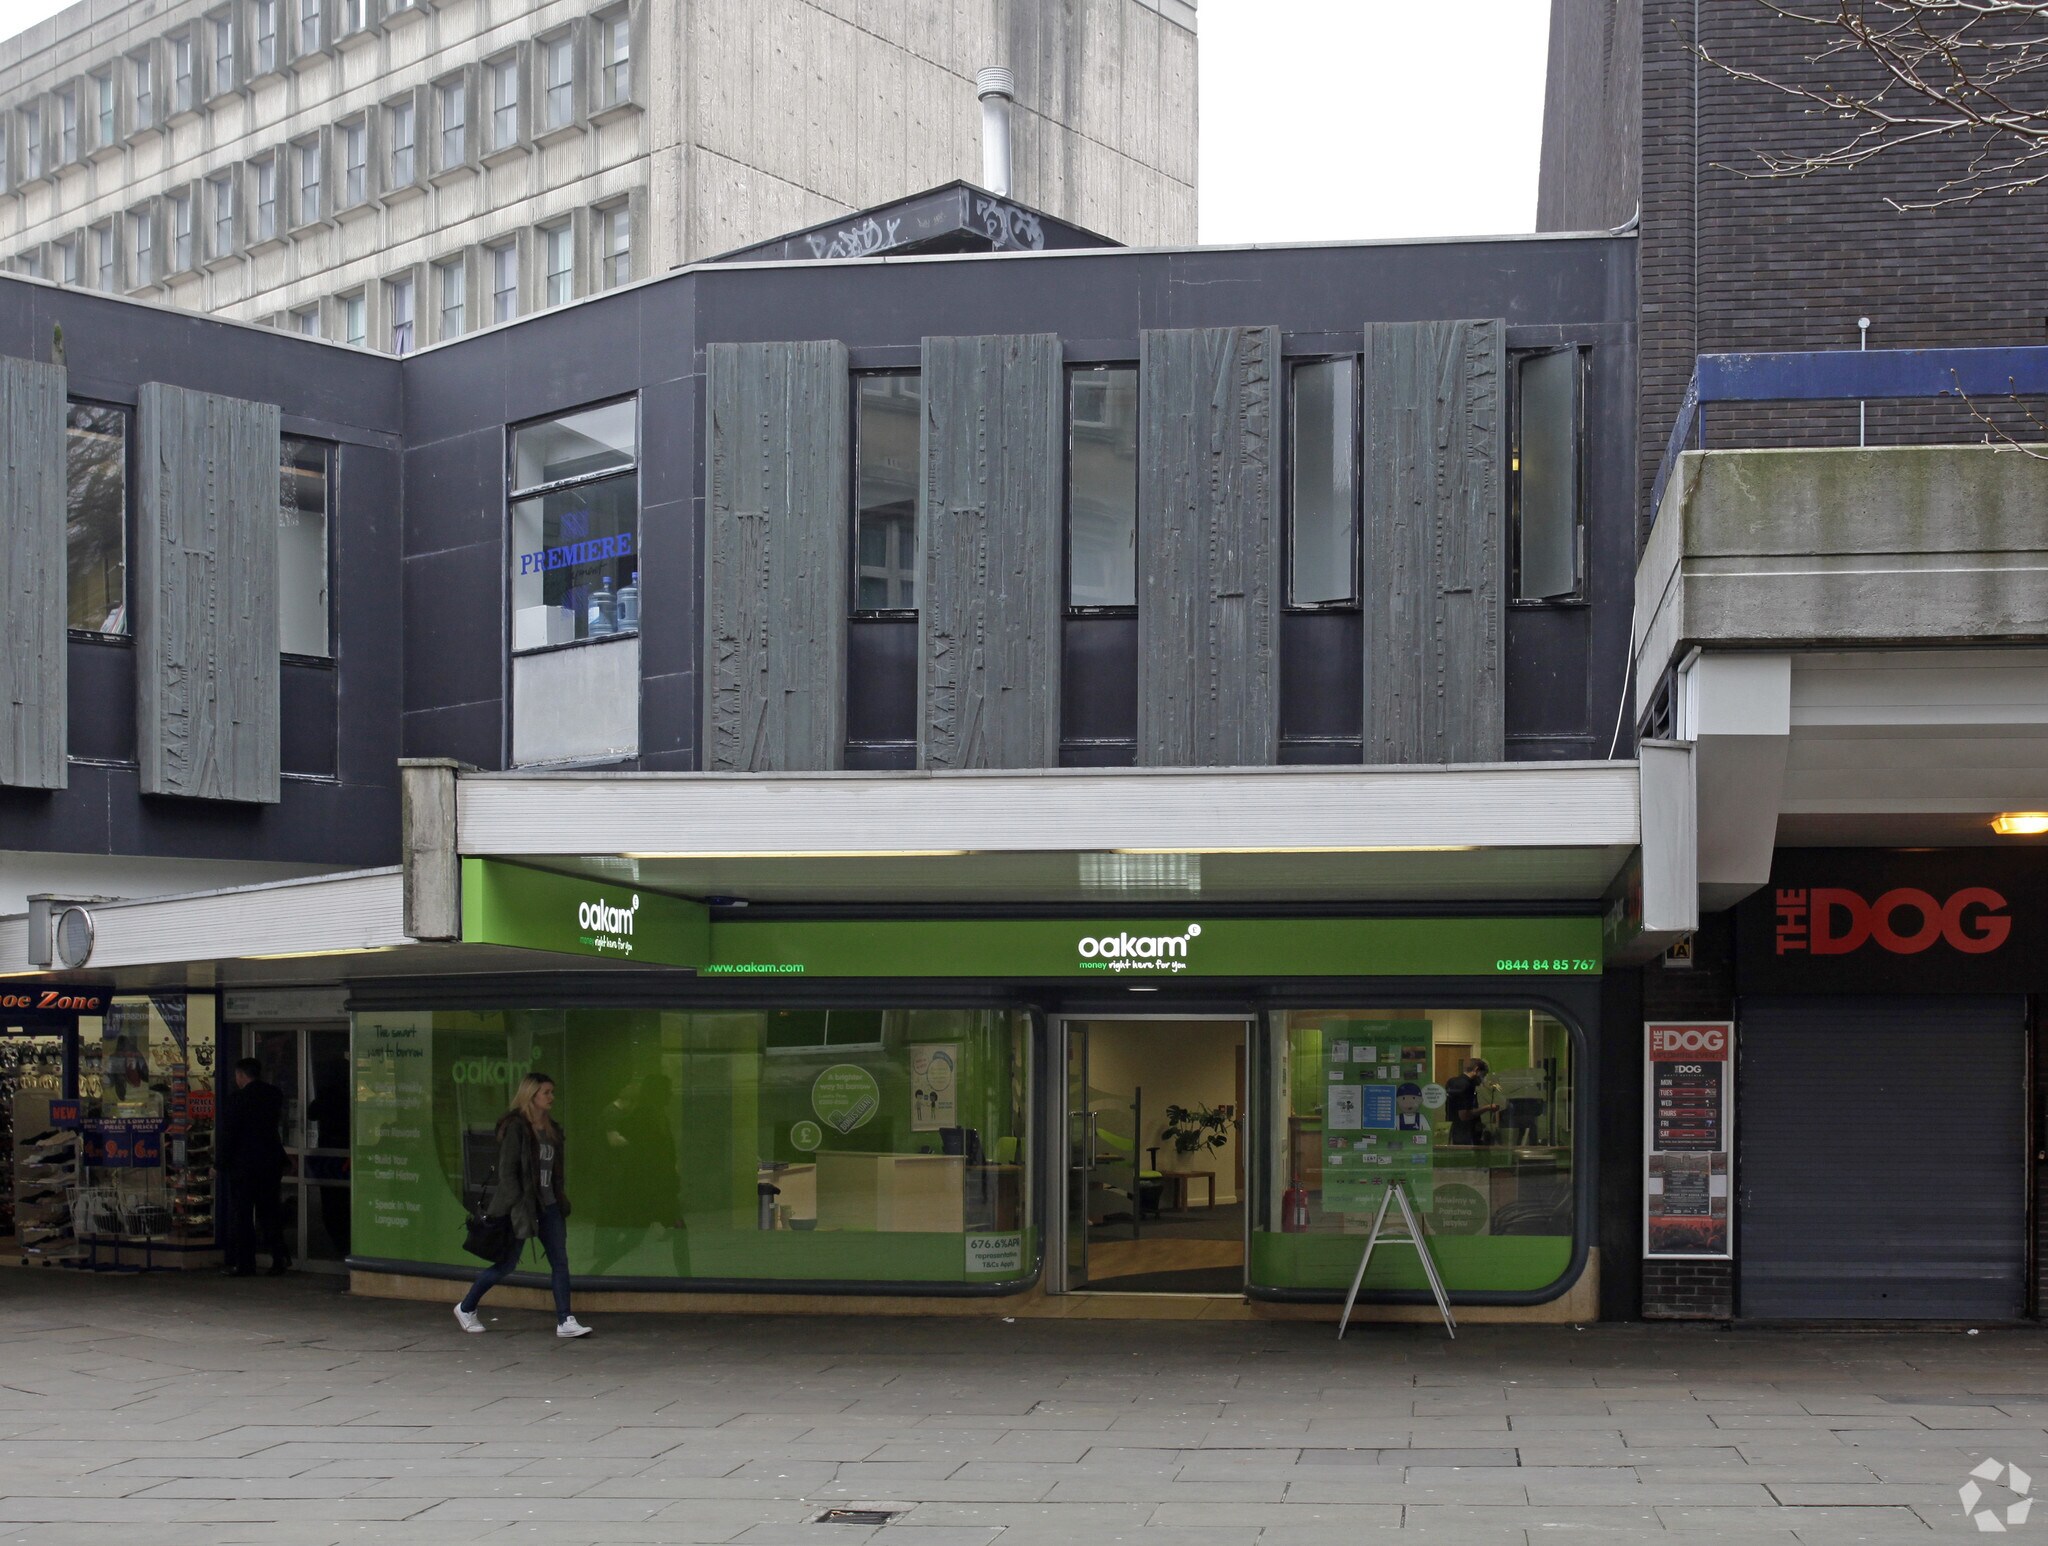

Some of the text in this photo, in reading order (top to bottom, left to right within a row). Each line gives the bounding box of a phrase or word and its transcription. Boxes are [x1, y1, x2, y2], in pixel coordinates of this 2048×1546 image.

[521, 533, 632, 575] PREMIERE
[579, 898, 633, 935] oakam
[1776, 888, 1807, 955] THE
[1810, 887, 2012, 955] DOG
[1078, 932, 1187, 957] oakam
[1079, 959, 1187, 973] money right here for you
[1496, 959, 1597, 971] 0844 84 85 767
[0, 993, 32, 1009] oe
[36, 991, 102, 1009] Zone
[374, 1024, 416, 1038] The smart
[1653, 1030, 1663, 1051] THE
[1663, 1030, 1724, 1051] DOG
[368, 1043, 423, 1063] way to borrow
[1679, 1065, 1702, 1074] DOG
[53, 1106, 77, 1120] NEW
[800, 1126, 812, 1144] £
